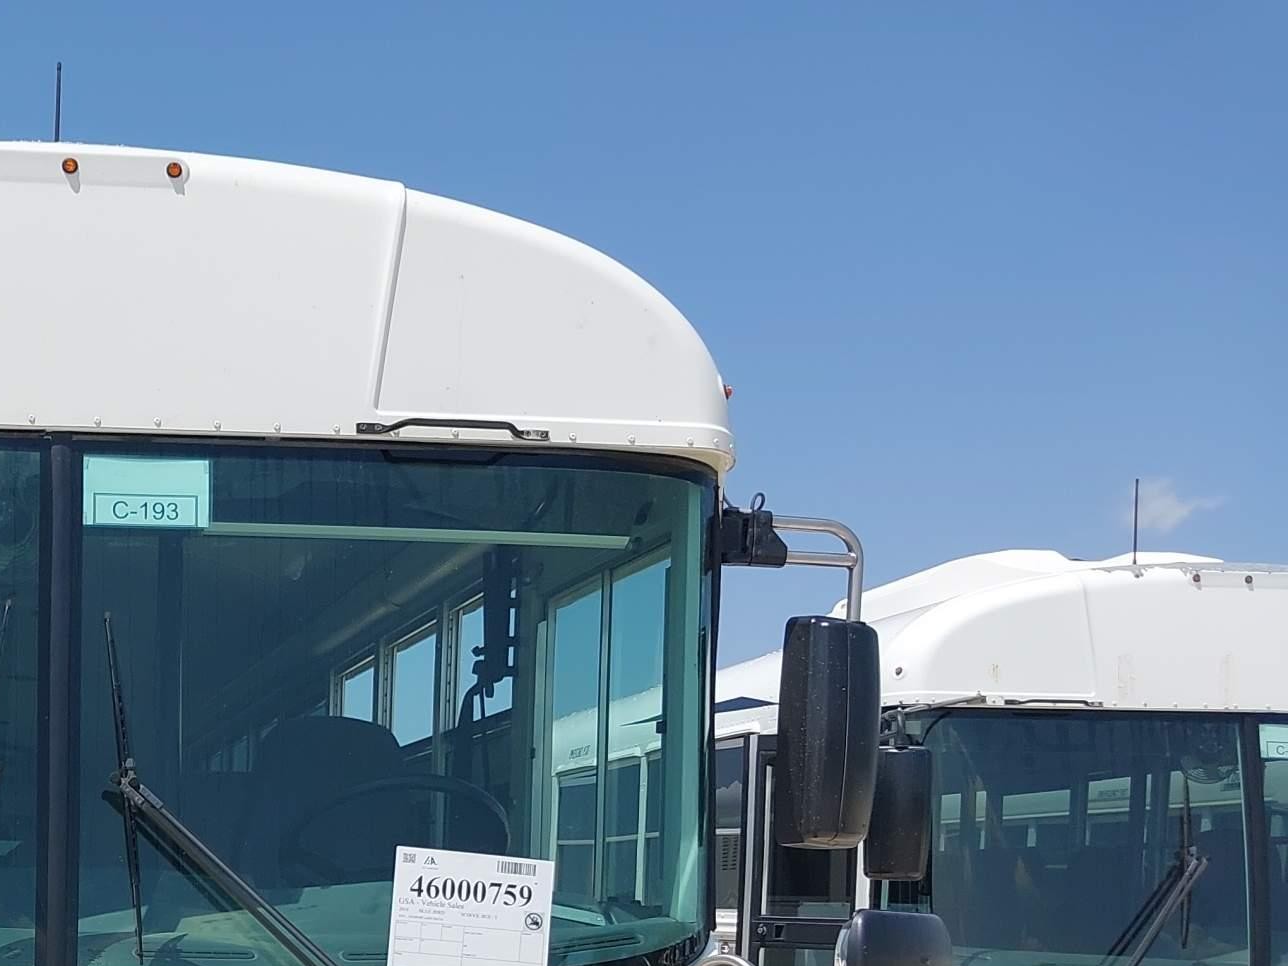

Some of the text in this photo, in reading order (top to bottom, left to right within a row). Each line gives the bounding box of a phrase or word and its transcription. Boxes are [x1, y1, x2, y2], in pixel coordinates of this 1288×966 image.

[112, 500, 179, 521] C-193
[409, 874, 533, 908] 46000759
[421, 899, 446, 908] Vehicle
